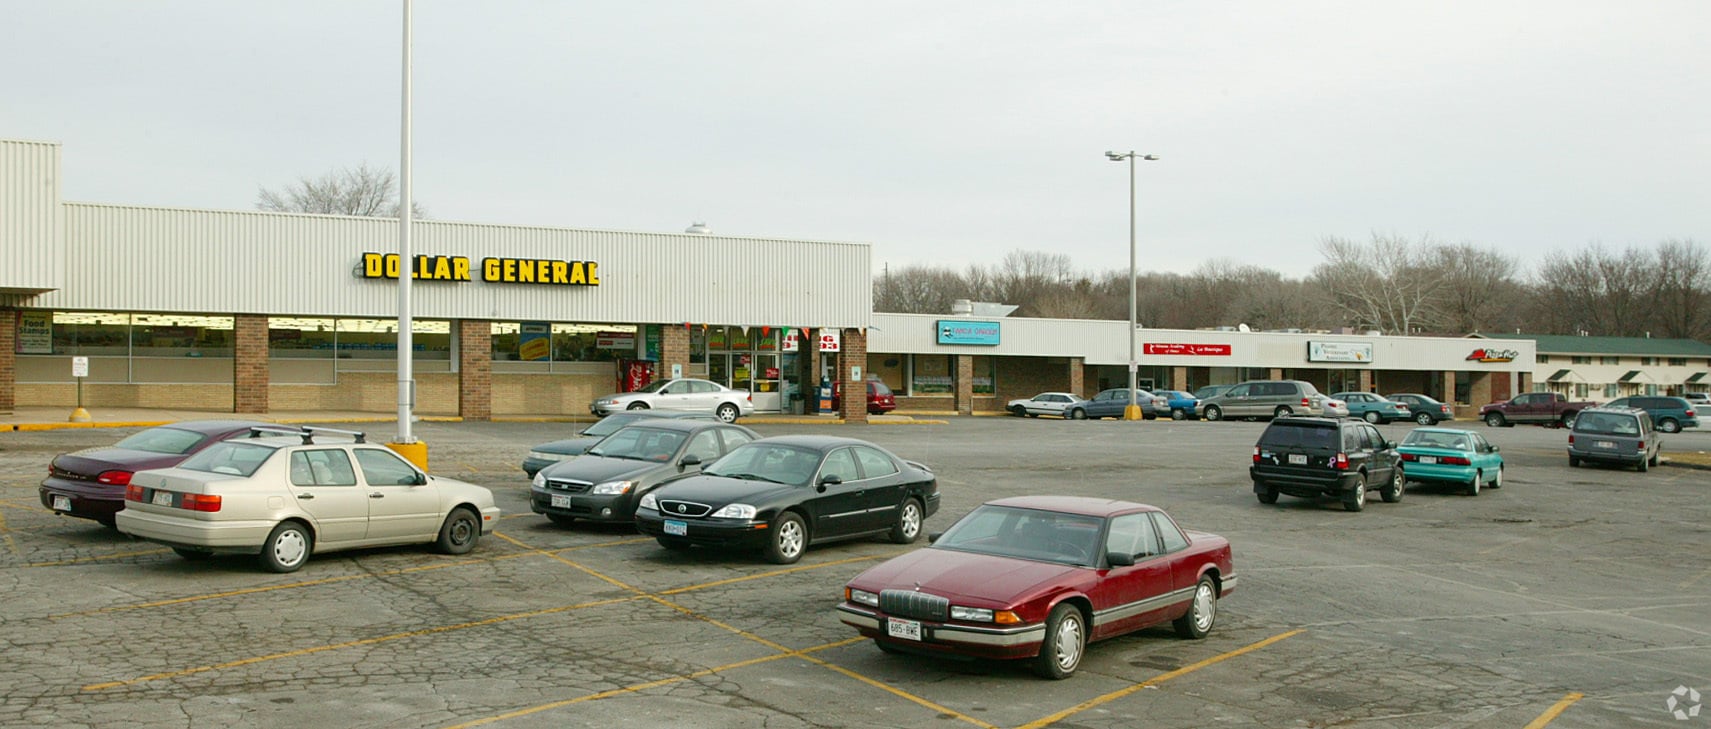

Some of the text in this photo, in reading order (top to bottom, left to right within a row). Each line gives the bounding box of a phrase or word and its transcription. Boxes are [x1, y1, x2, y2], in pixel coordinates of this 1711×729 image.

[482, 257, 599, 286] GENERAL
[24, 319, 45, 327] Food
[19, 327, 50, 335] Stamps
